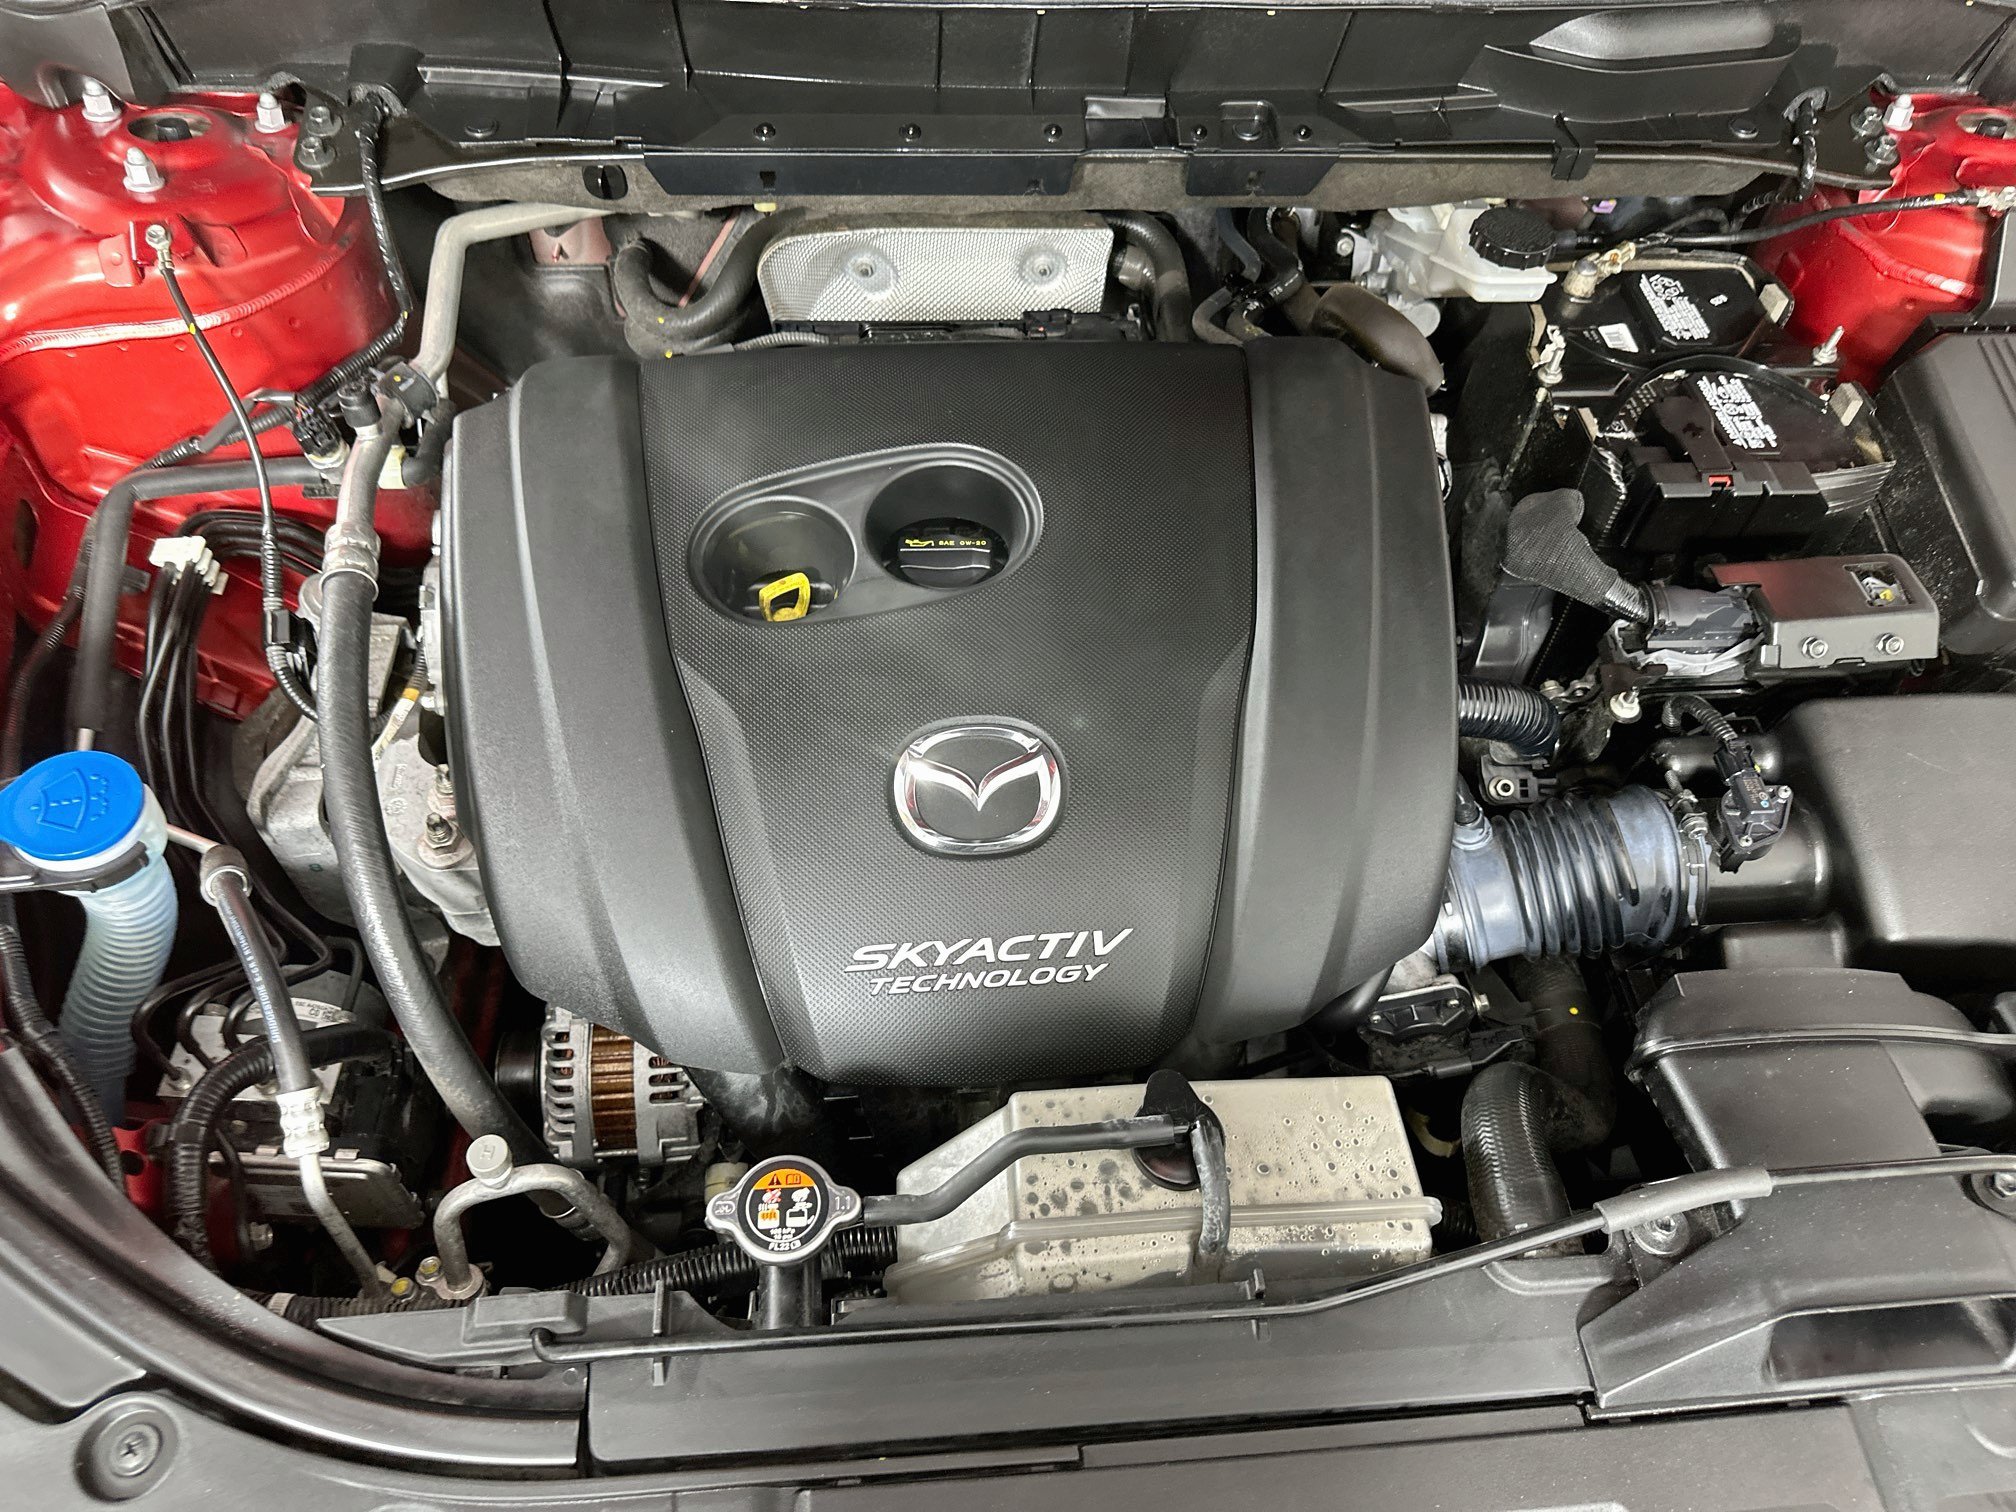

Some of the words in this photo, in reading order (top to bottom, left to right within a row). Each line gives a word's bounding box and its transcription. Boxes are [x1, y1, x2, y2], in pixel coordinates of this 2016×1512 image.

[844, 928, 1134, 973] SKYACTIV
[869, 963, 1110, 996] TECHNOLOGY
[834, 1195, 851, 1210] 1.1
